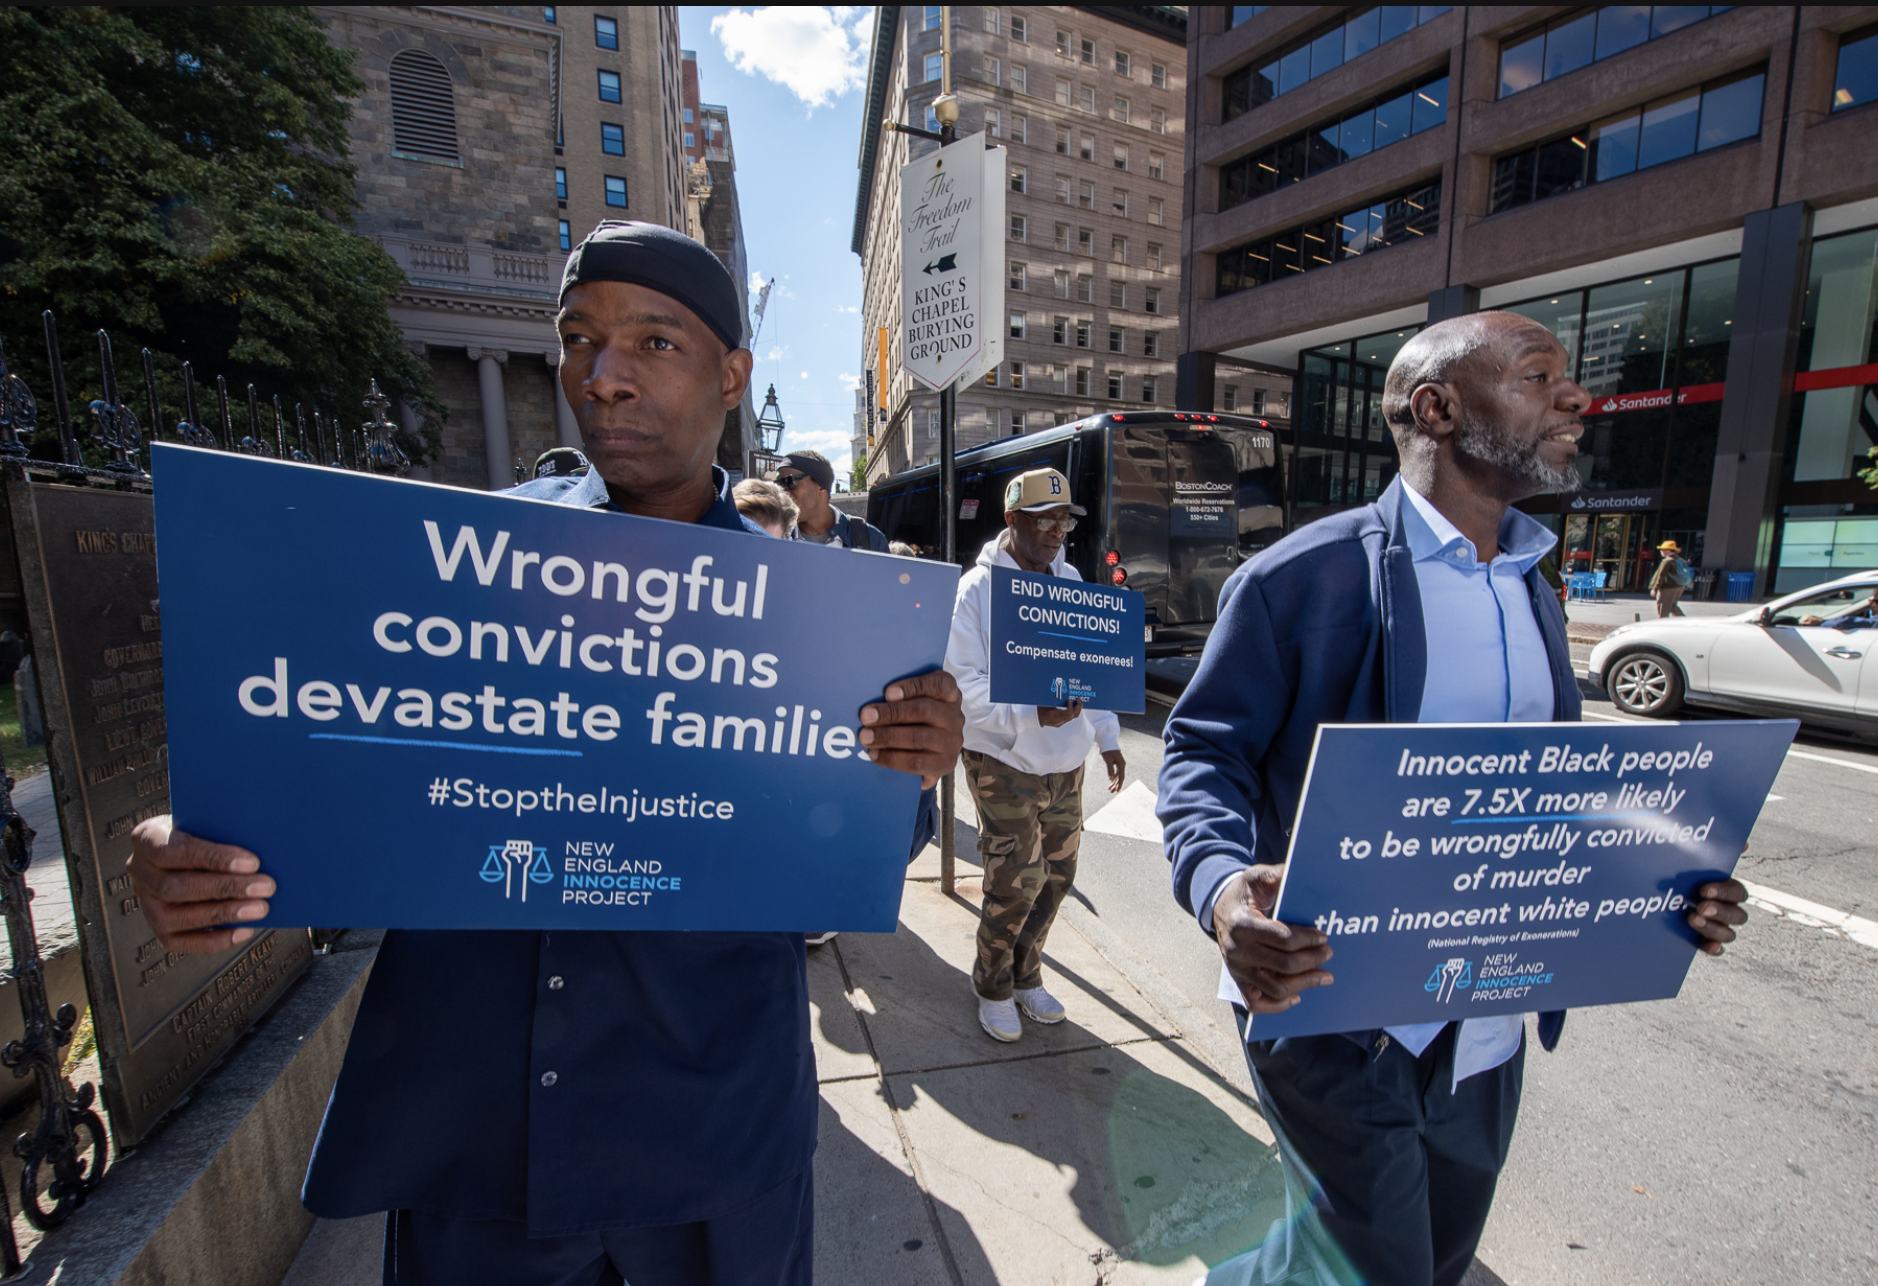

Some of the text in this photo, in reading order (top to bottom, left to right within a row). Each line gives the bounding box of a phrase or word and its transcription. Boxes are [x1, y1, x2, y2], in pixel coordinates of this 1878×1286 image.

[921, 171, 955, 203] The
[908, 193, 975, 233] Freedom
[920, 218, 961, 253] Trail
[912, 296, 970, 324] CHAPEL
[908, 313, 975, 344] BURYING
[910, 333, 972, 361] GROUND
[1252, 436, 1270, 448] 1170
[1047, 475, 1062, 495] B
[1587, 496, 1652, 509] Santander
[422, 519, 768, 624] Wrongful
[1011, 578, 1127, 613] END WRONGFUL
[1018, 605, 1120, 634] CONVICTIONS!
[373, 610, 780, 689] convictions
[1006, 640, 1133, 668] Compensate exonerees!
[1068, 683, 1092, 692] ENGLAND
[238, 657, 873, 761] devastate familie
[1397, 741, 1714, 779] Innocent Black people
[428, 777, 735, 823] #StoptheInjustice
[1402, 781, 1687, 818] are 7.5X more likely
[566, 841, 615, 857] NEW
[1339, 816, 1715, 860] to be wrongfully convicted
[564, 858, 662, 874] ENGLAND
[1453, 861, 1592, 892] of murder
[563, 874, 682, 891] INNOCENCE
[562, 890, 652, 905] PROJECT
[1314, 910, 1380, 937] than
[1387, 902, 1511, 934] innocent
[1518, 895, 1590, 923] white
[1427, 928, 1580, 950] (National Registry of Exonerations)
[142, 960, 167, 987] JOHN
[1480, 961, 1544, 978] ENGLAND
[1483, 952, 1518, 967] NEW
[1471, 986, 1532, 1002] PROJECT
[1475, 973, 1554, 990] INNOCENCE
[172, 991, 213, 1034] CAPTAIN
[216, 958, 248, 995] ROBERT
[187, 1015, 210, 1044] FIRST
[213, 975, 255, 1019] COMMANDER
